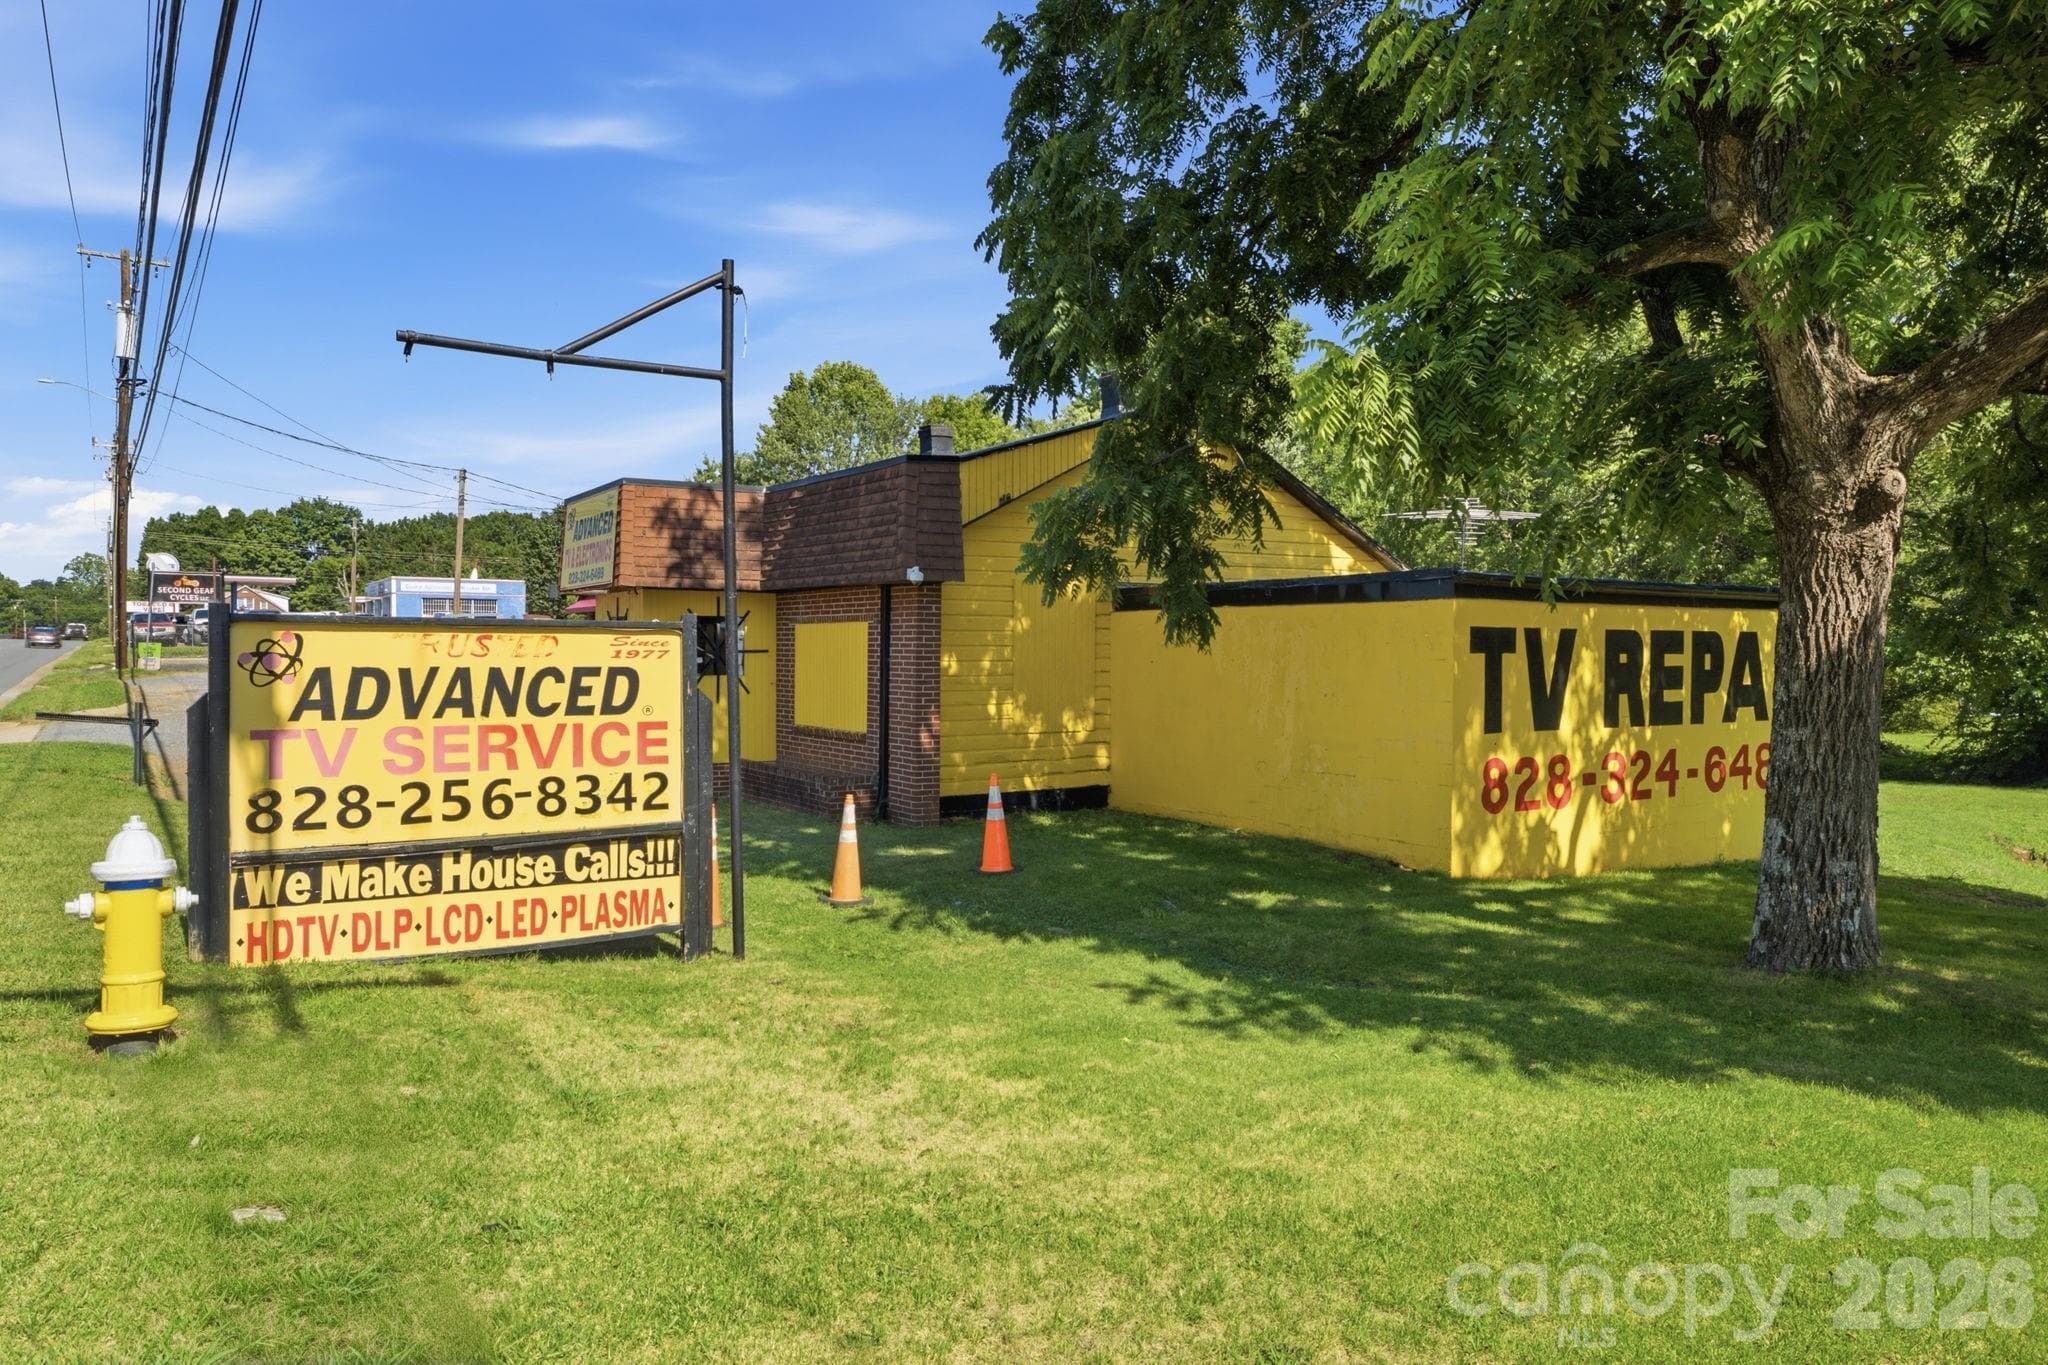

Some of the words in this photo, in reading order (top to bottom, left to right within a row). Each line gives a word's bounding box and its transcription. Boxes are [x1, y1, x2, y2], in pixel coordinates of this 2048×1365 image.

[573, 511, 613, 541] ADVANCED
[157, 586, 192, 594] SECOND
[609, 636, 670, 648] Since
[610, 649, 670, 659] 1977
[288, 666, 640, 722] ADVANCED
[1469, 626, 1577, 735] TV
[1603, 629, 1770, 729] REPA
[249, 728, 358, 781] TV
[383, 721, 669, 777] SERVICE
[245, 771, 670, 834] 828-256-8342
[242, 863, 312, 908] We
[321, 856, 434, 904] Make
[441, 848, 555, 894] House
[563, 838, 676, 883] Calls!!!
[351, 908, 413, 953] DLP
[425, 903, 483, 946] LCD
[495, 895, 553, 940] LED
[560, 888, 667, 932] PLASMA
